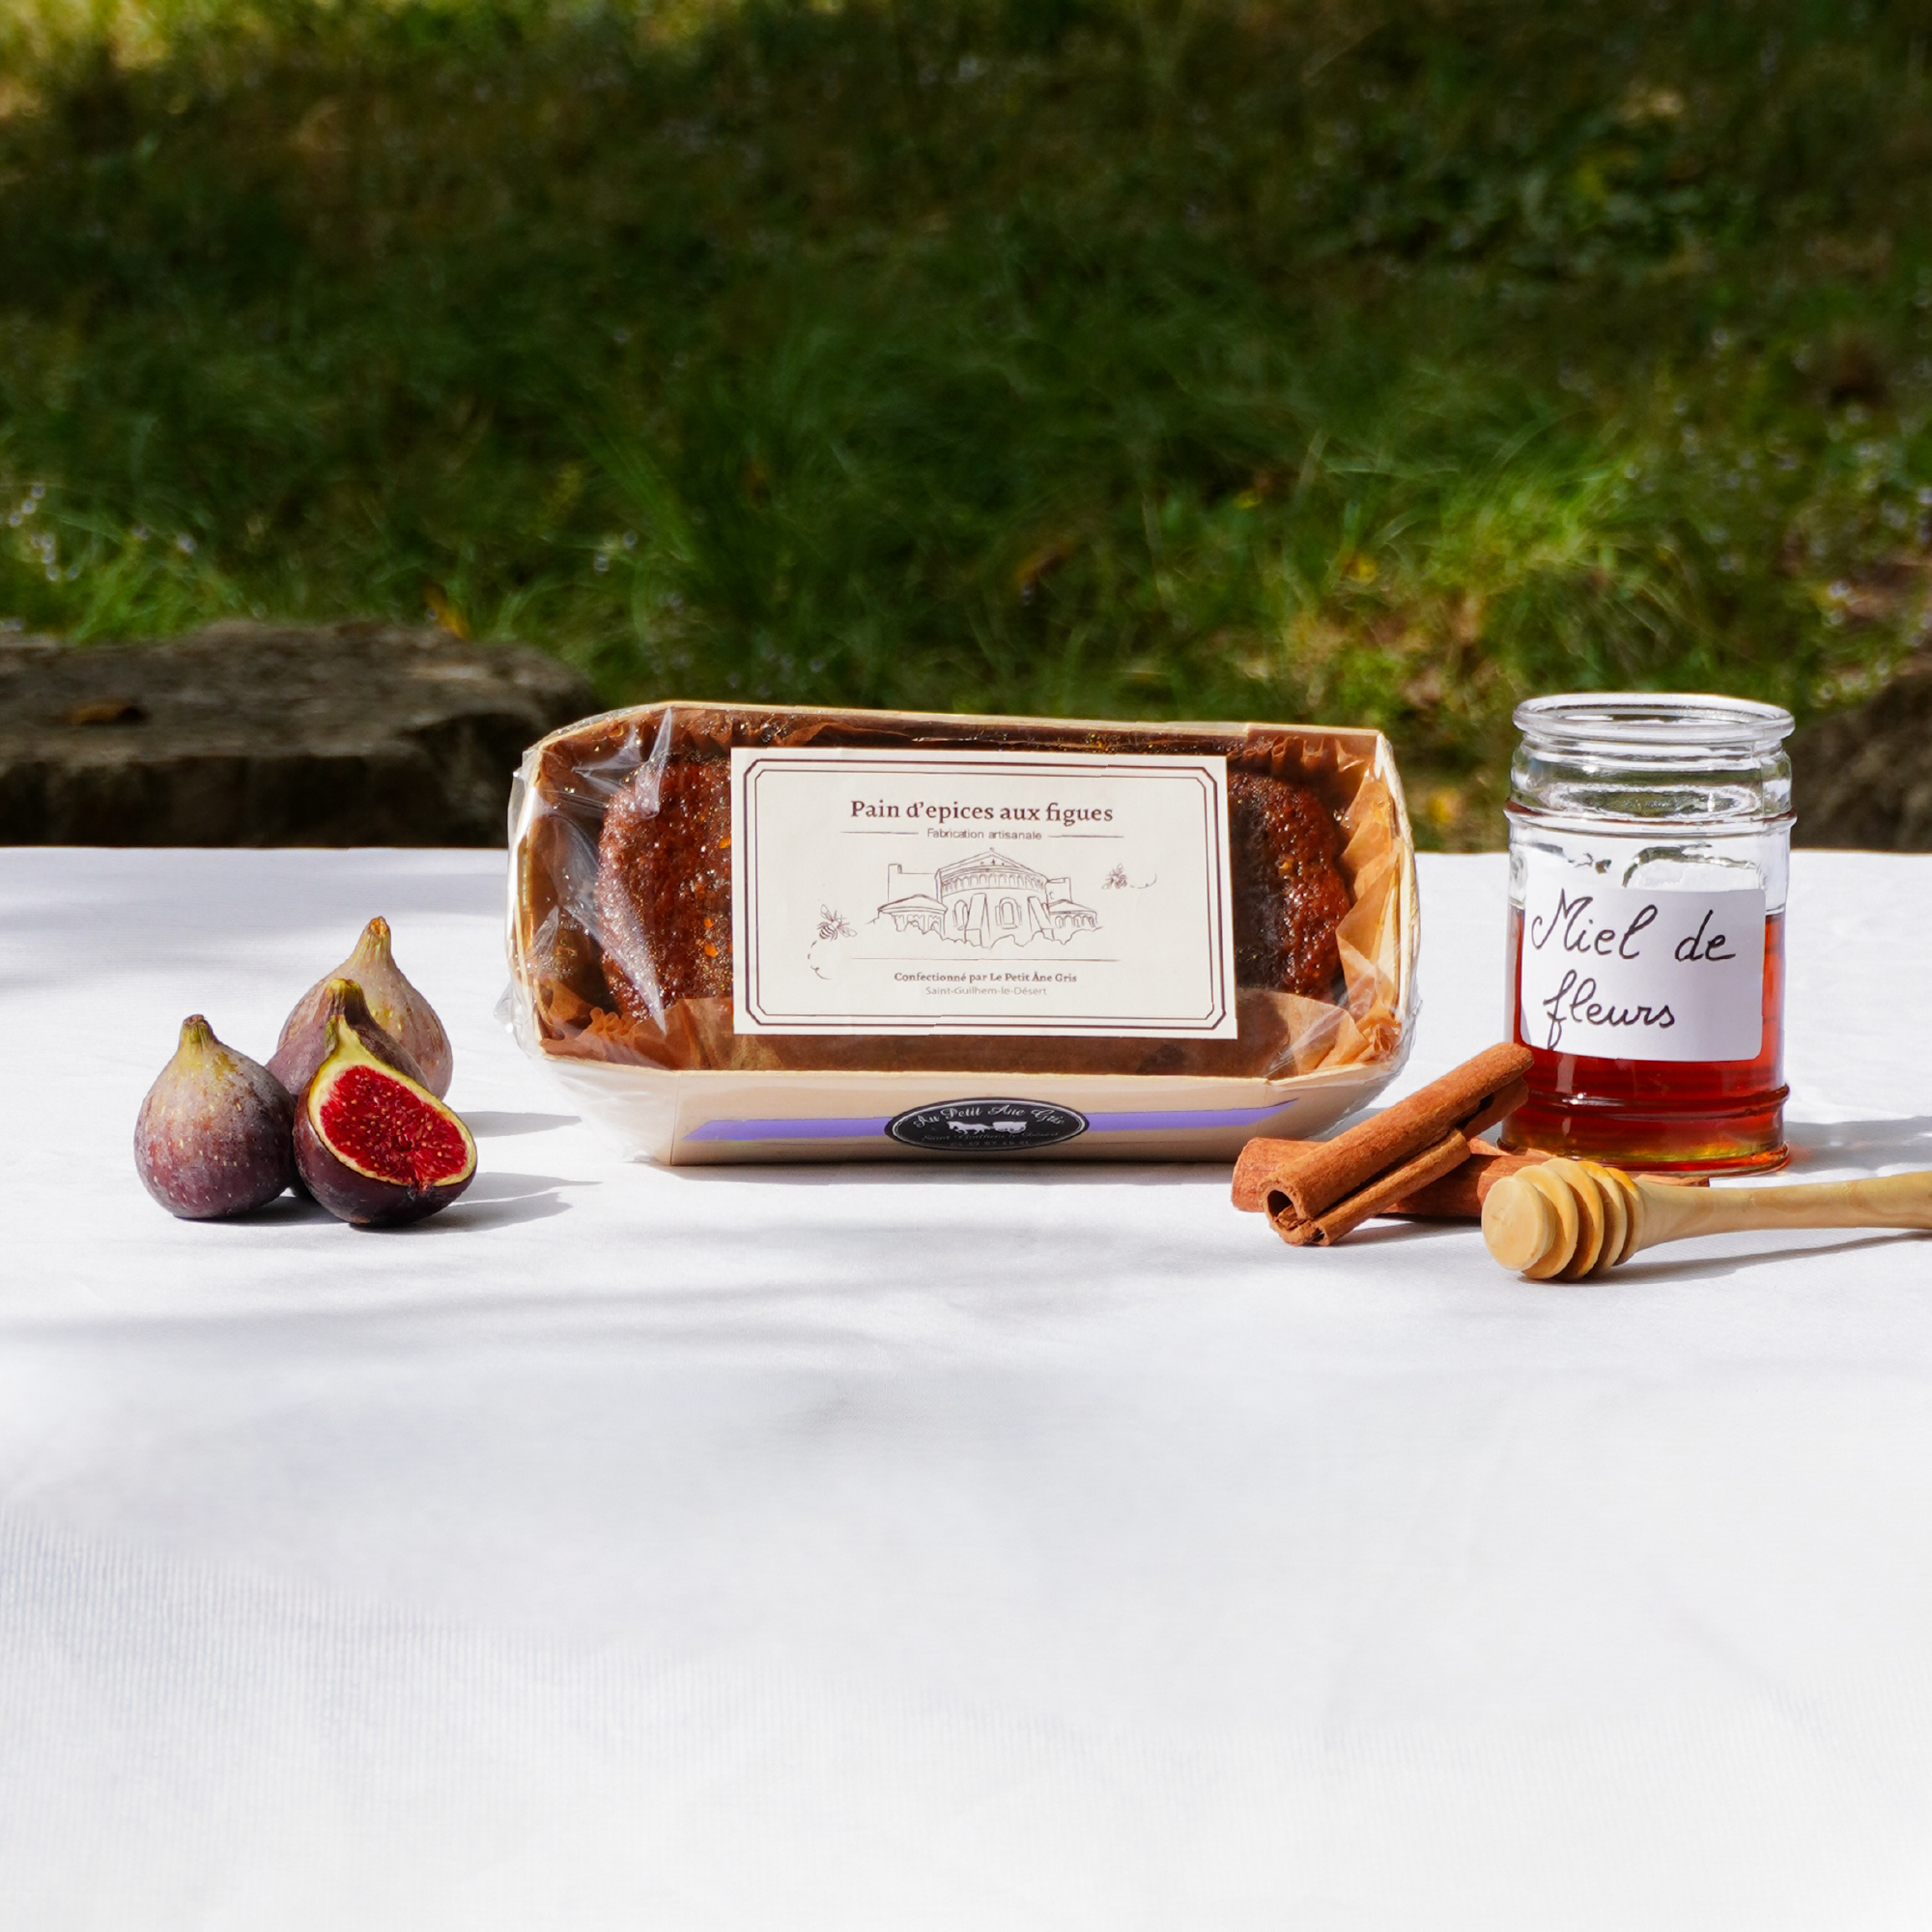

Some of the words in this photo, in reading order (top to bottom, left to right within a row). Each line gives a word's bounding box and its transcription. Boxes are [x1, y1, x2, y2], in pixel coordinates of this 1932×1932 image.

[850, 800, 899, 818] Pain
[1000, 807, 1040, 821] aux
[1045, 803, 1114, 827] figues
[927, 828, 984, 839] Fabrication
[988, 829, 1042, 840] artisanale
[1531, 887, 1659, 960] Miel
[1674, 909, 1737, 962] de
[894, 972, 966, 982] Confectionné
[969, 974, 987, 983] par
[990, 973, 1002, 981] Le
[1005, 973, 1030, 982] Petit
[1032, 971, 1053, 982] Âne
[1055, 973, 1077, 982] Gris
[925, 986, 1047, 996] Saint-Guilhem-le-Désert
[1543, 969, 1675, 1051] fleurs
[940, 1107, 982, 1120] Petit
[1031, 1109, 1065, 1125] Gris
